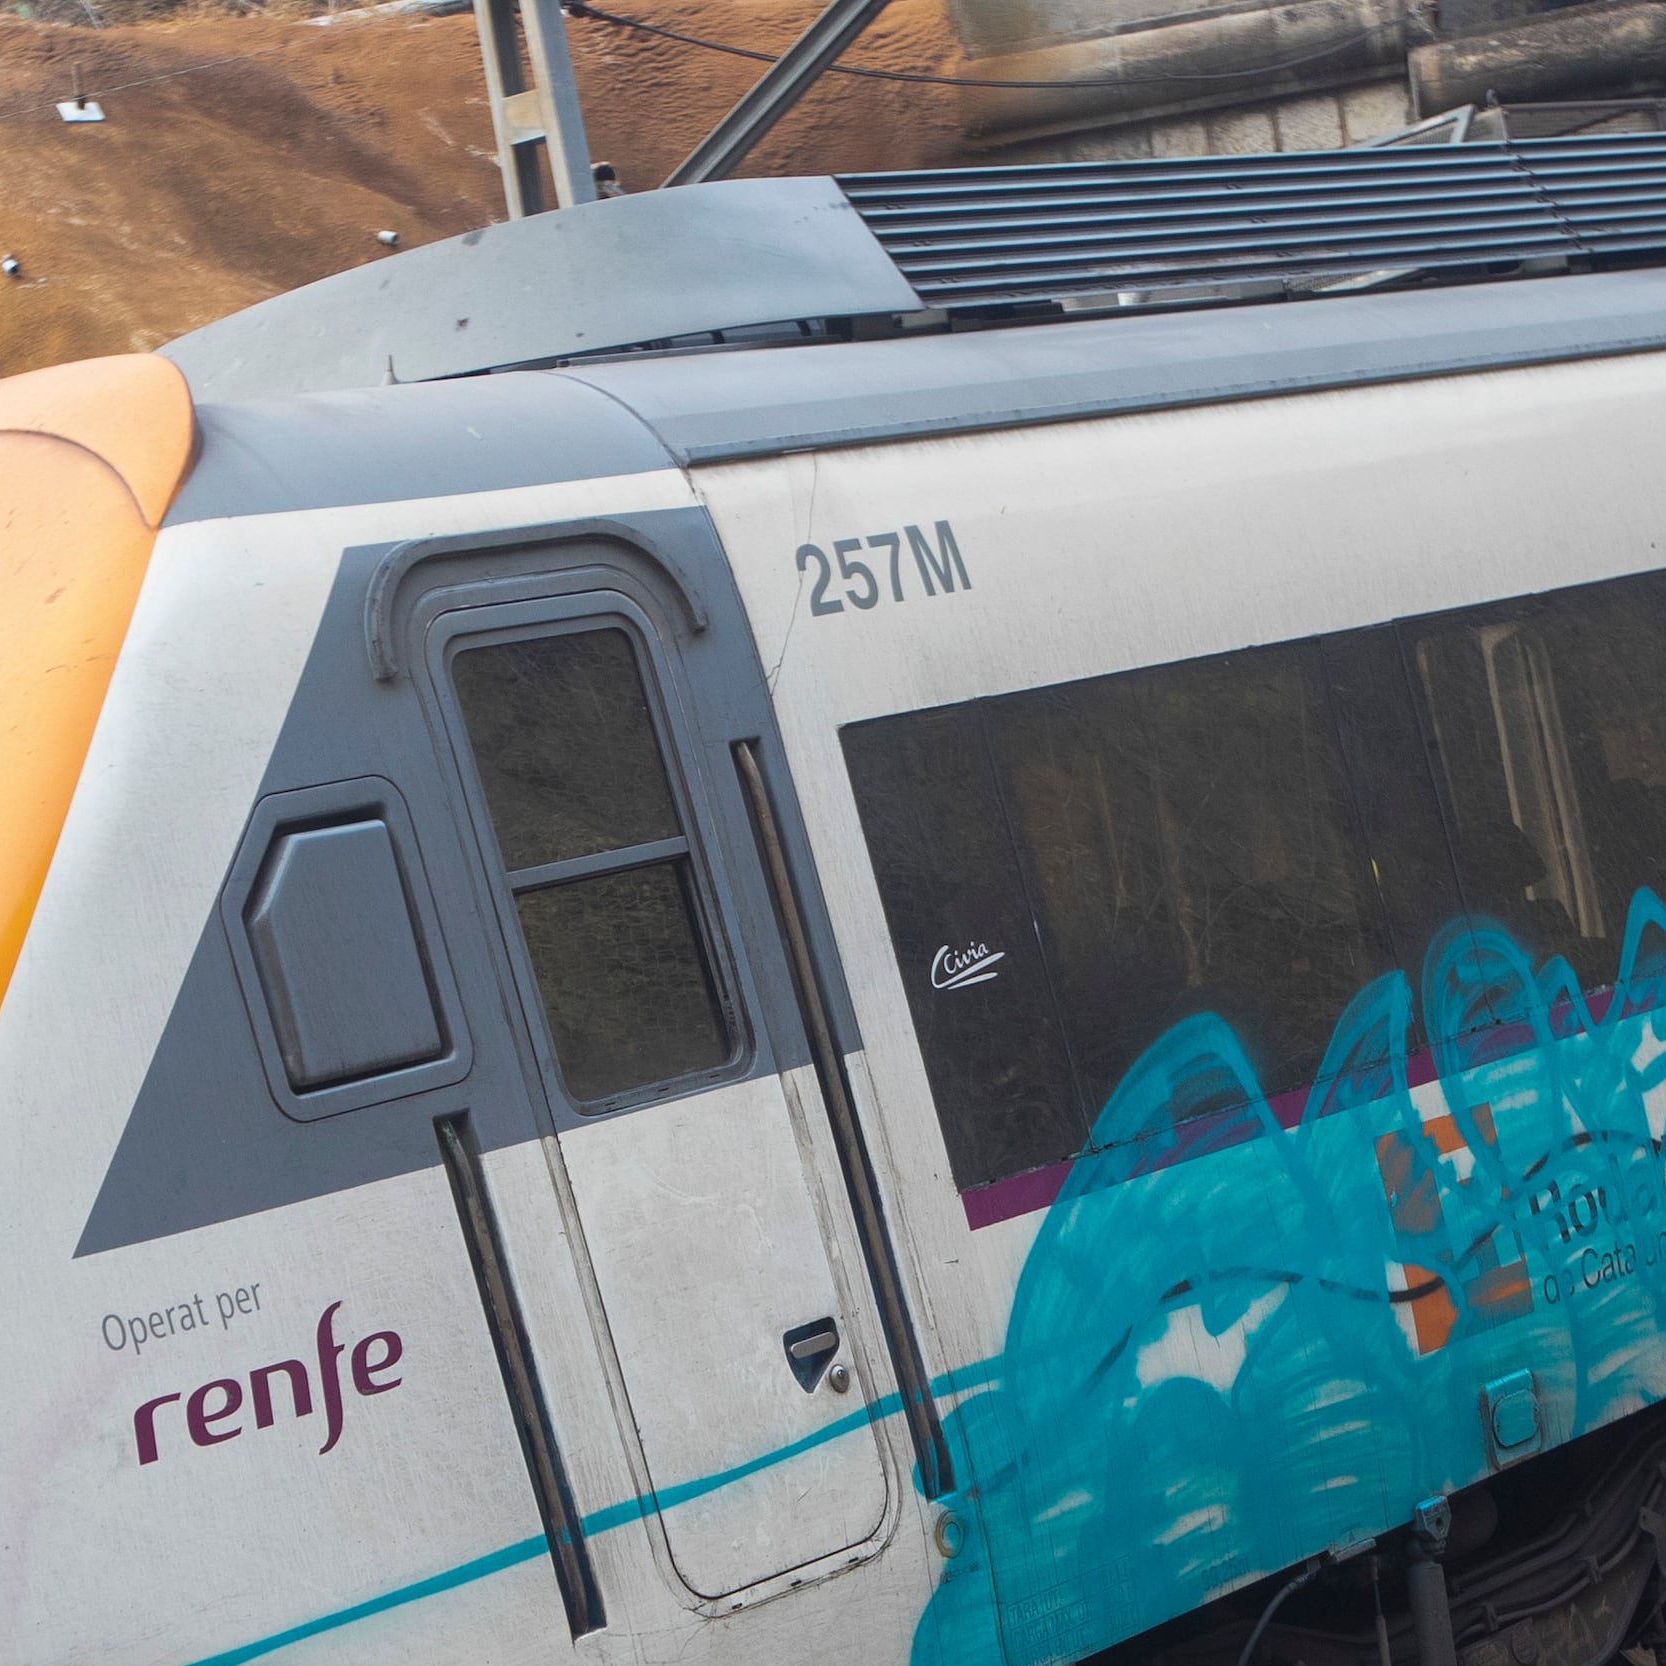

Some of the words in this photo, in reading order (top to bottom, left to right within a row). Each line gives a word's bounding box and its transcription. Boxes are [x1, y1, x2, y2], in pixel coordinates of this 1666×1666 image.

[796, 520, 972, 617] 257M
[101, 1293, 209, 1356] Operat
[215, 1283, 261, 1331] per
[133, 1300, 403, 1466] renfe
